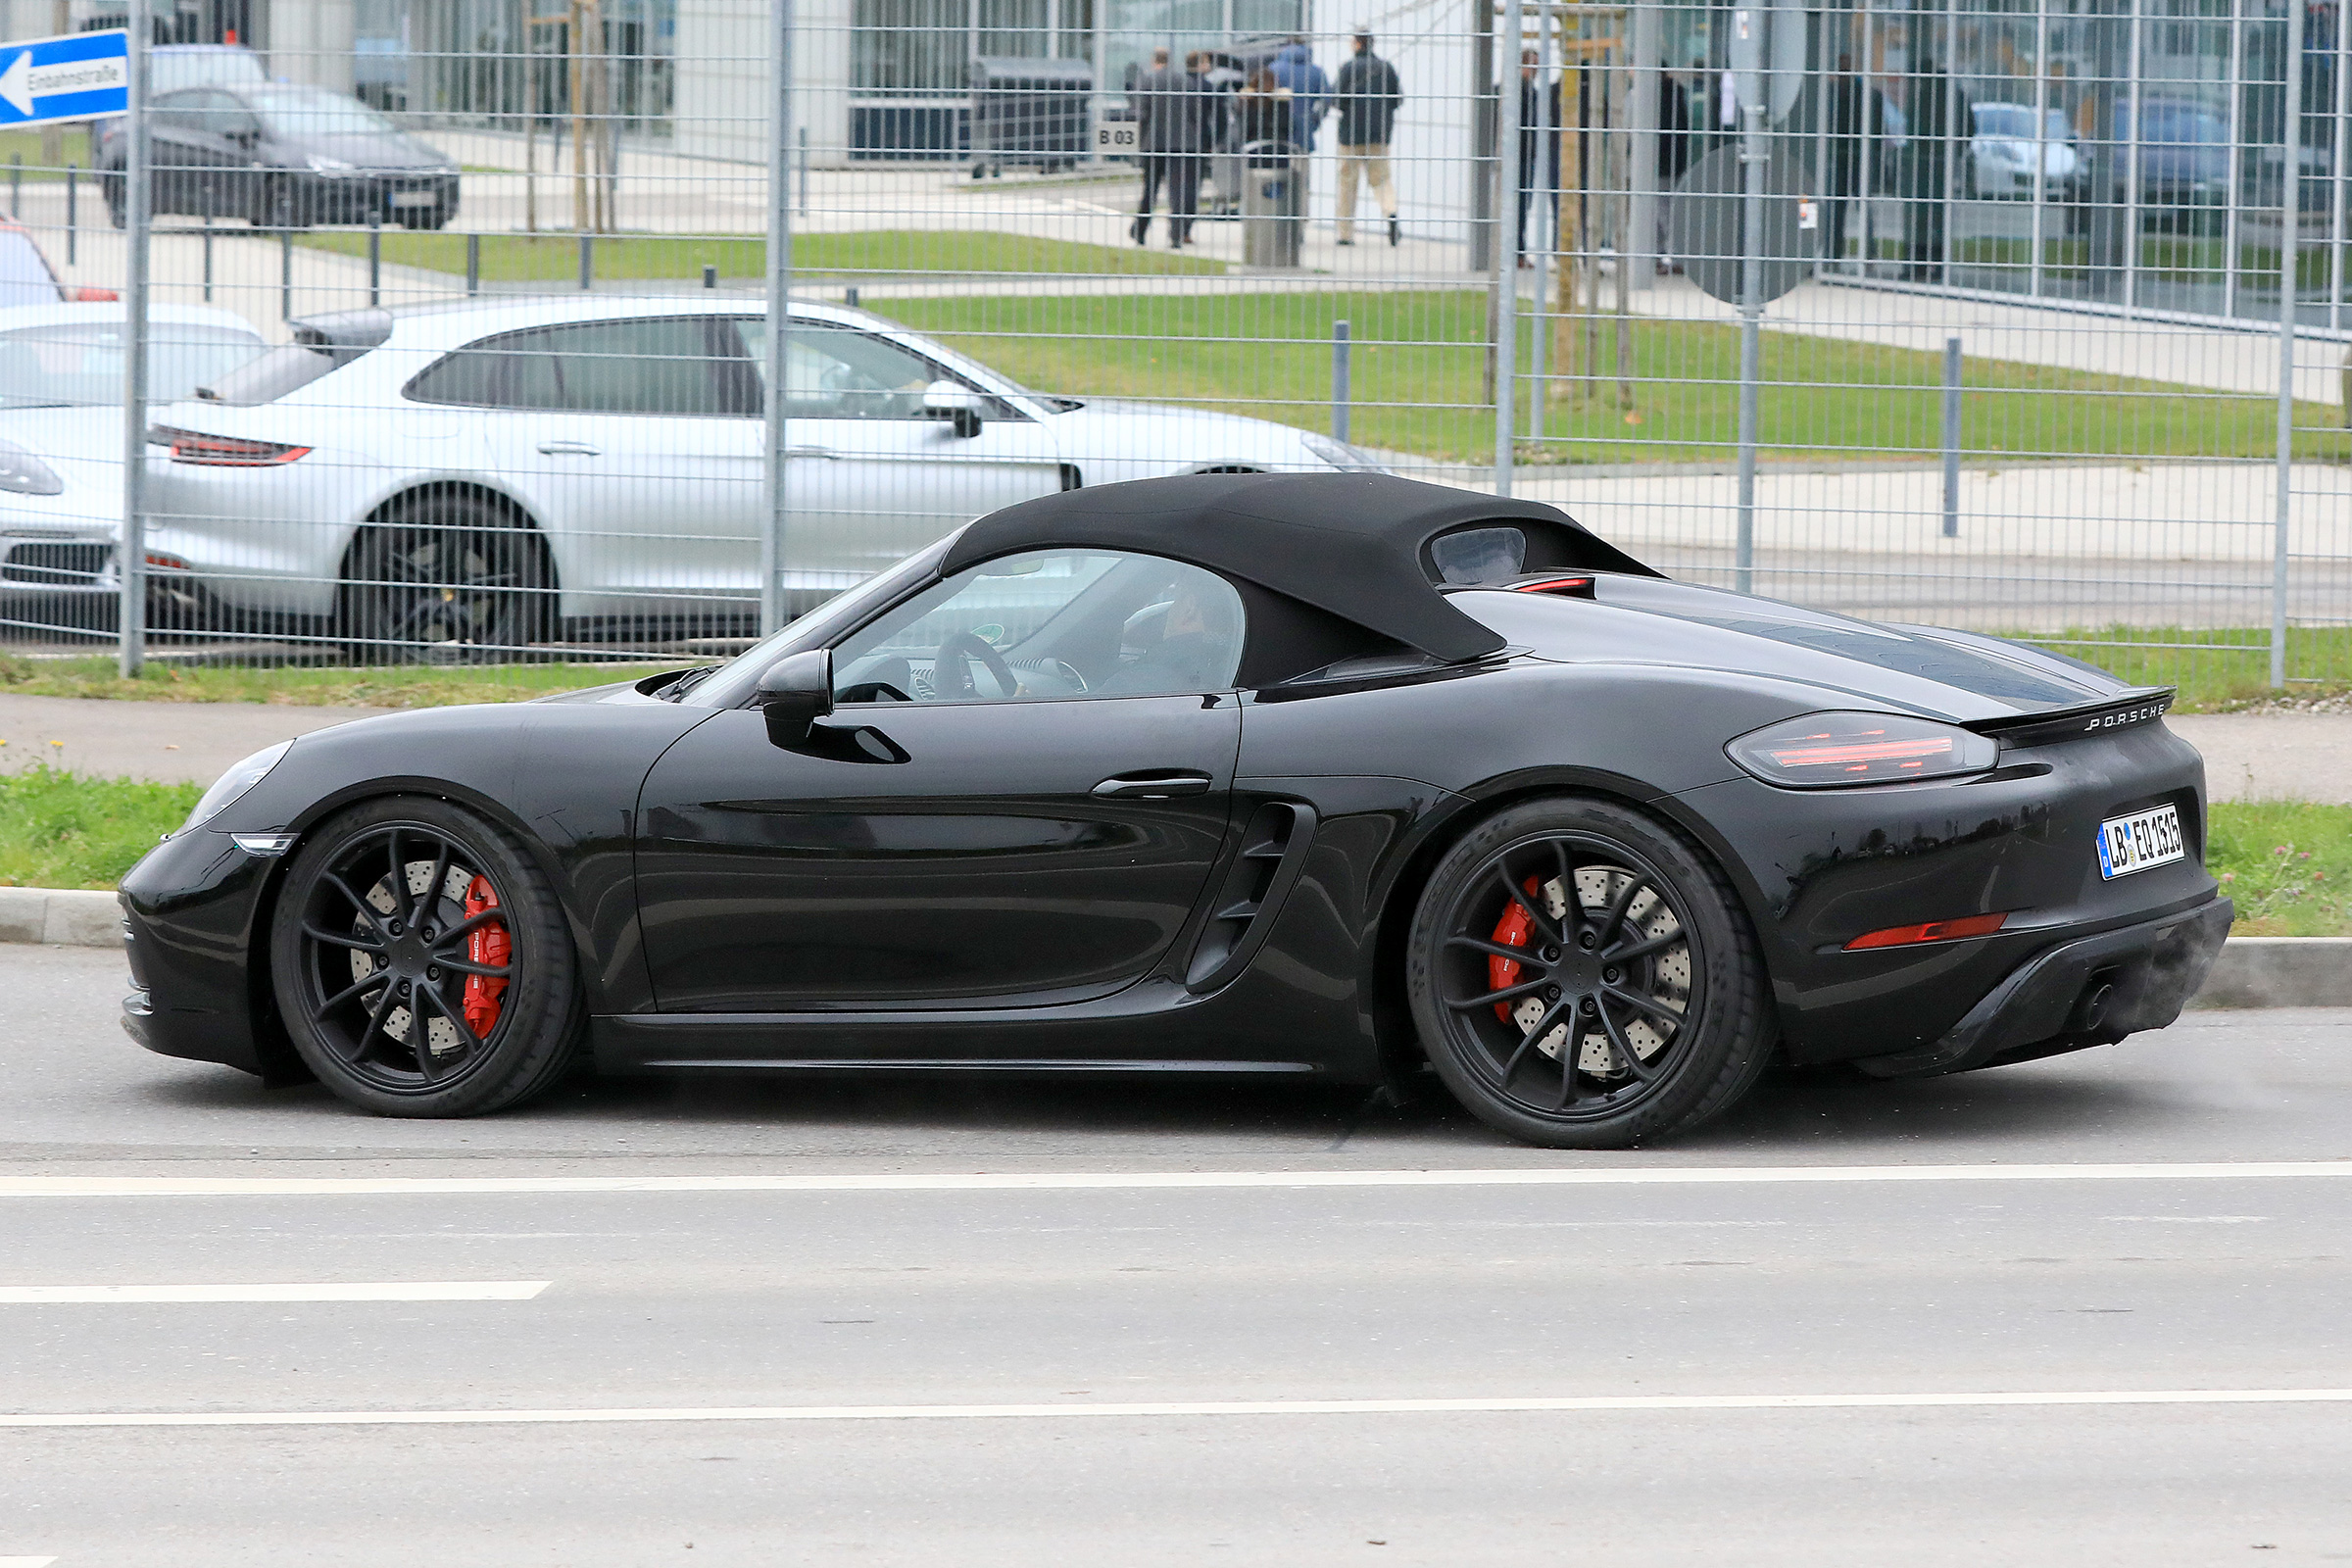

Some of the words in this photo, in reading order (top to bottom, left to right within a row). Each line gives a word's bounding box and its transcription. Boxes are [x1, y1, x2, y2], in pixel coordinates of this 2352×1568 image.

[1099, 129, 1109, 145] B
[1114, 129, 1135, 145] 03
[2083, 704, 2165, 731] PORSCHE
[2105, 825, 2128, 868] LB
[2152, 811, 2181, 858] 1515
